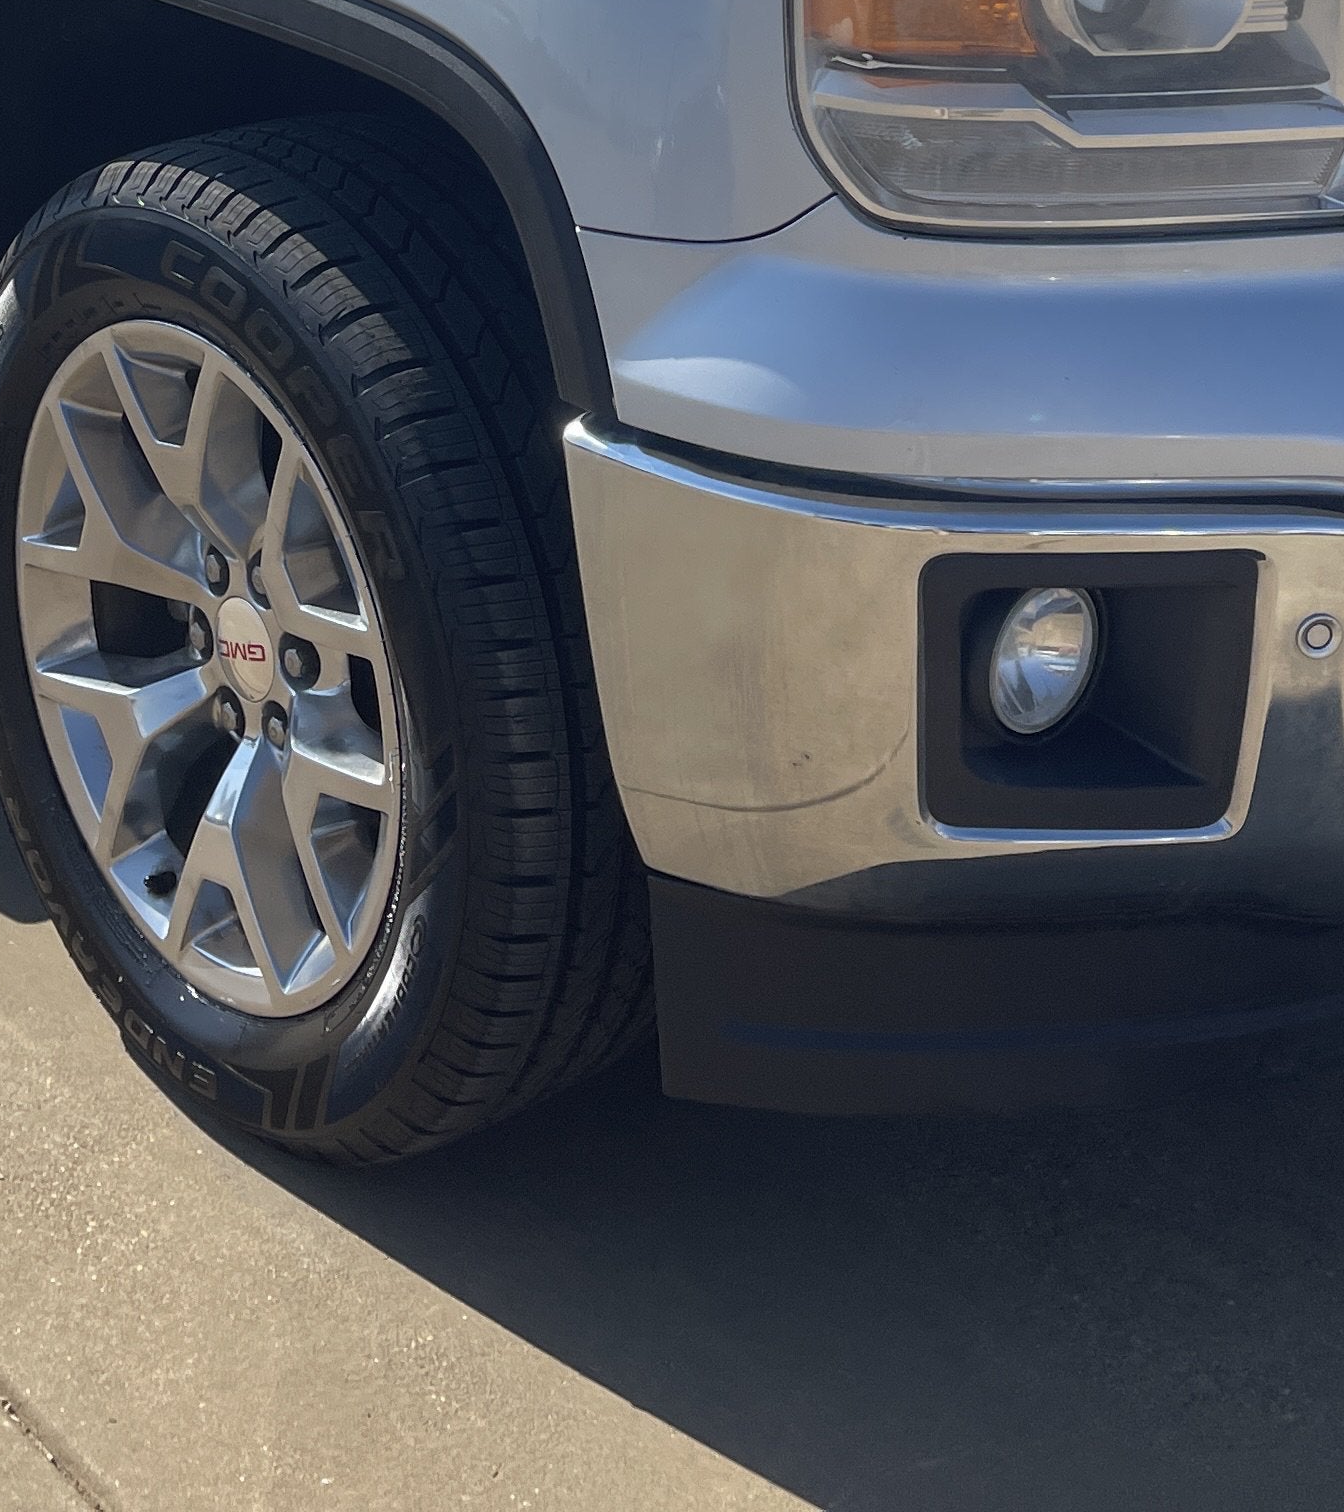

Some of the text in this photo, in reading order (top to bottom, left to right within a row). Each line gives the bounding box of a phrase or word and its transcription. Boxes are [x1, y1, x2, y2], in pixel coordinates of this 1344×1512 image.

[159, 239, 404, 581] COOPER
[218, 639, 266, 663] GMC
[3, 794, 218, 1102] ENDEAVOR
